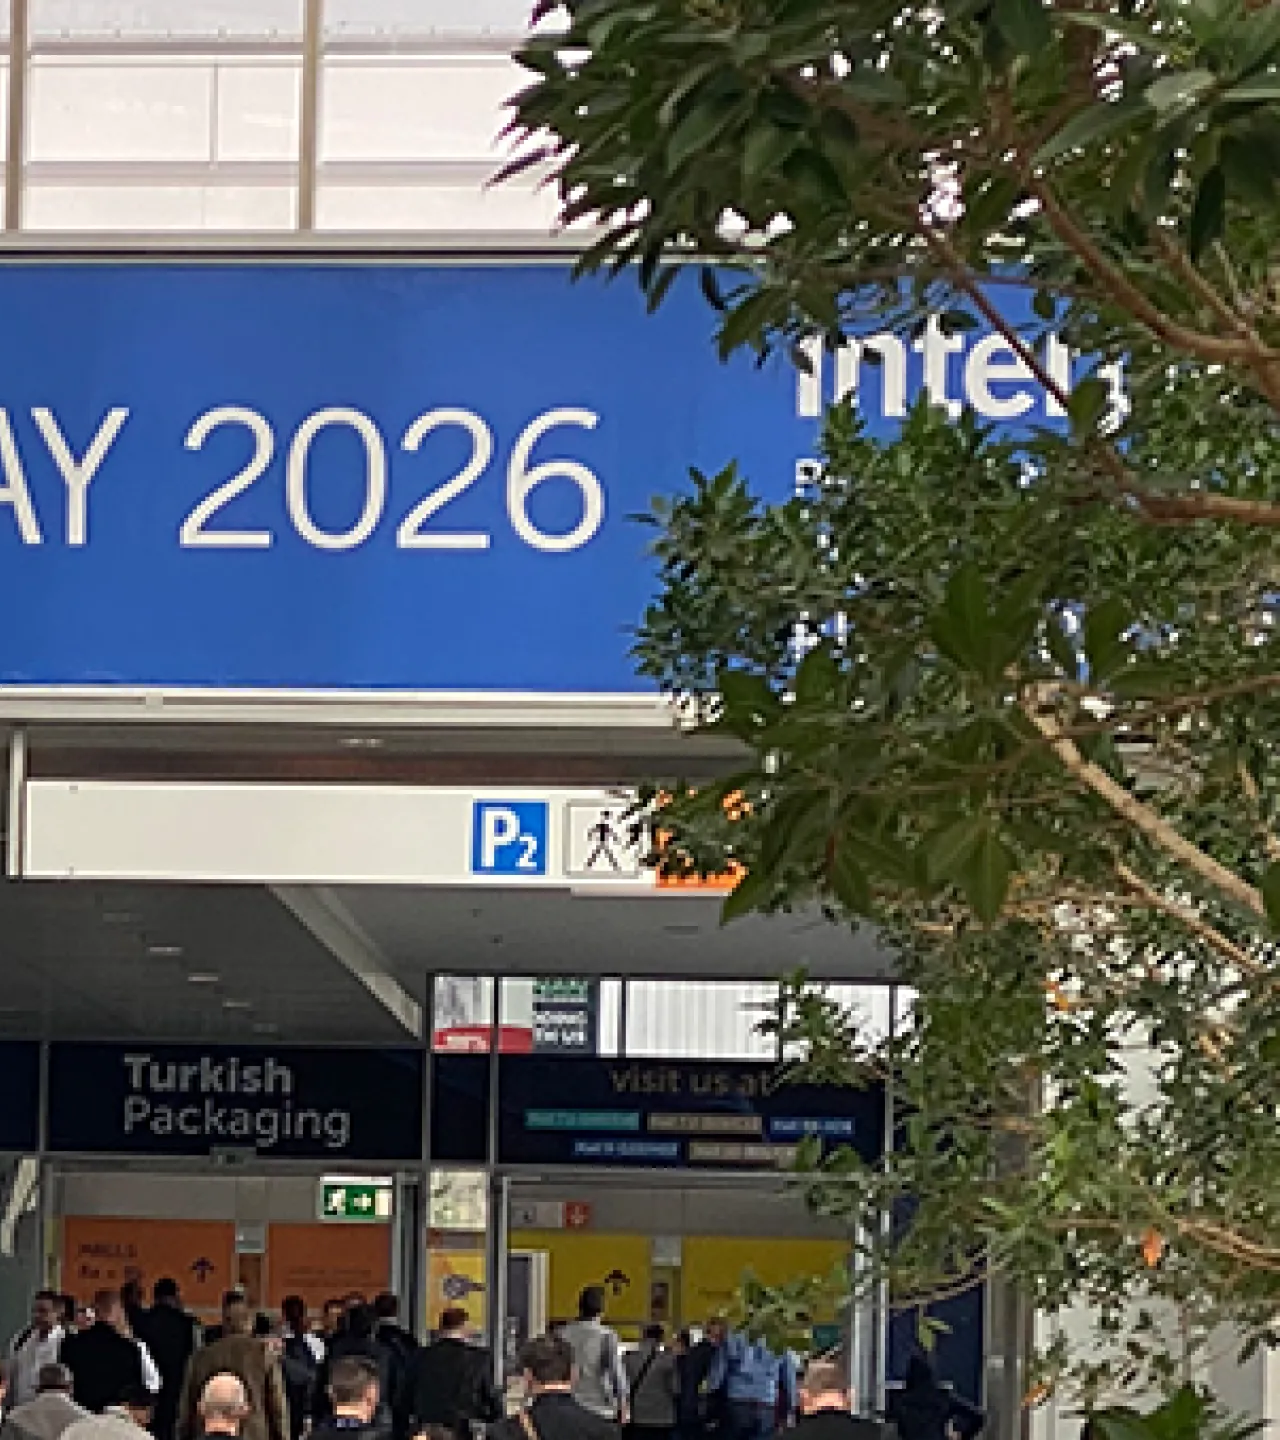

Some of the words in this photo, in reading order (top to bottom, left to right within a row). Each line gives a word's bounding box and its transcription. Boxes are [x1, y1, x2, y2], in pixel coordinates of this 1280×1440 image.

[177, 406, 605, 553] 2026
[124, 1053, 293, 1093] Turkish
[610, 1064, 679, 1093] visit
[689, 1071, 728, 1096] us
[738, 1069, 771, 1098] at
[124, 1096, 351, 1147] Packaging
